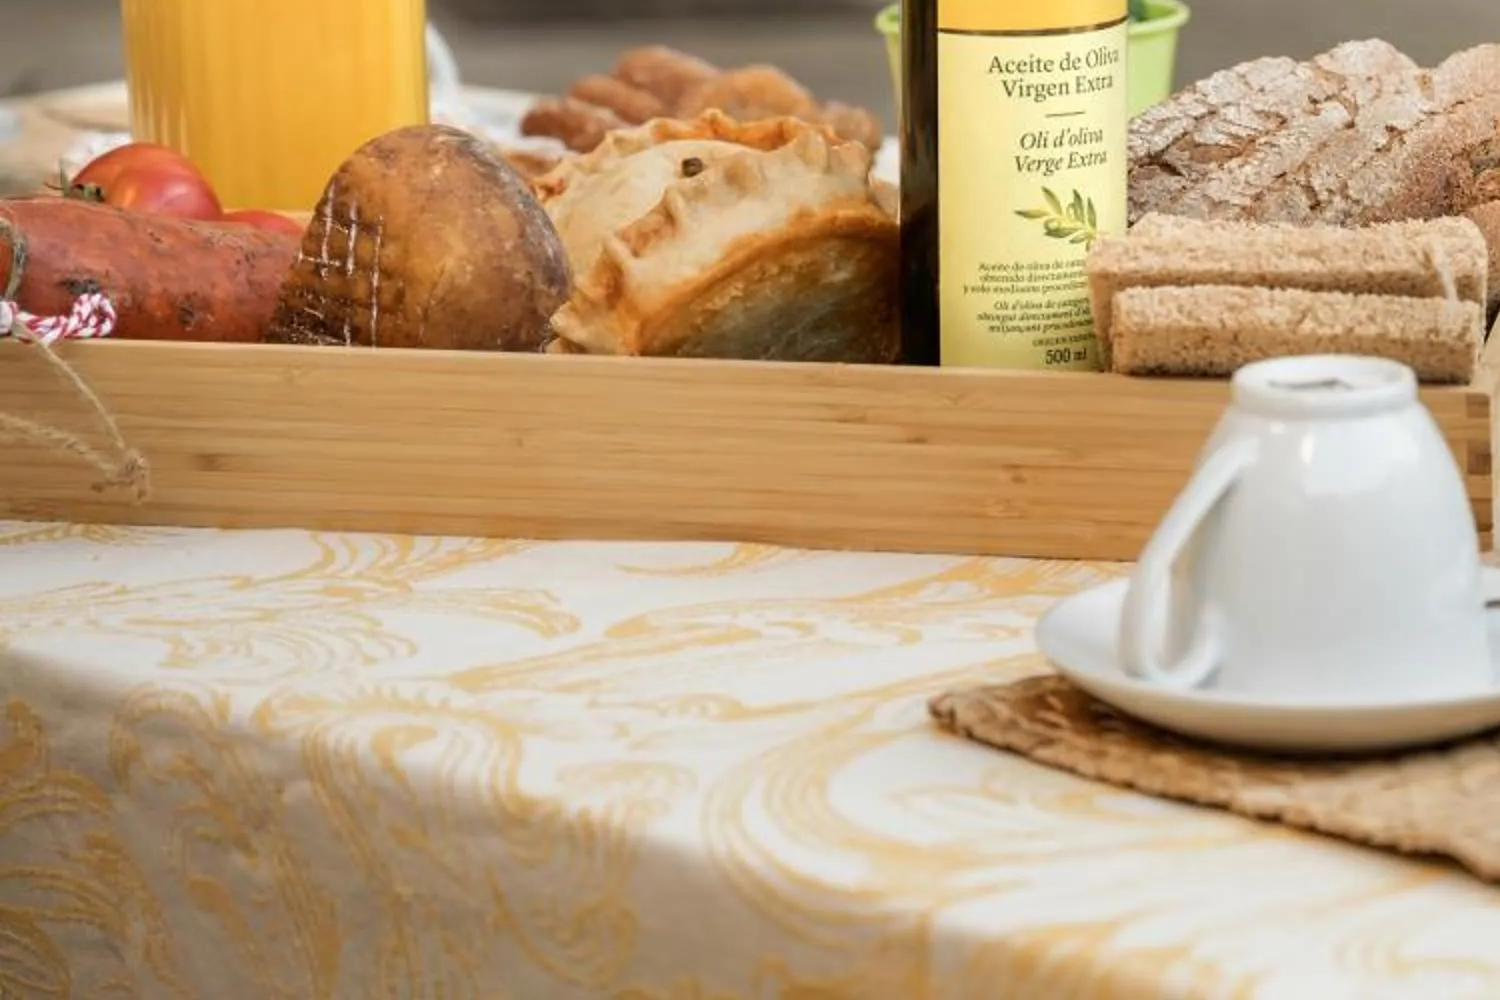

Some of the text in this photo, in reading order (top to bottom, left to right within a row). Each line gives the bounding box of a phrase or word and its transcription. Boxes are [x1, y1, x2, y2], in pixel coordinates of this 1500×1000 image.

[988, 46, 1119, 75] Aceite de Oliva
[1001, 73, 1113, 103] Virgen Extra
[1020, 128, 1104, 150] Oli d'oliva
[1014, 150, 1107, 177] Verge Extra
[1046, 347, 1087, 365] 500 ml
